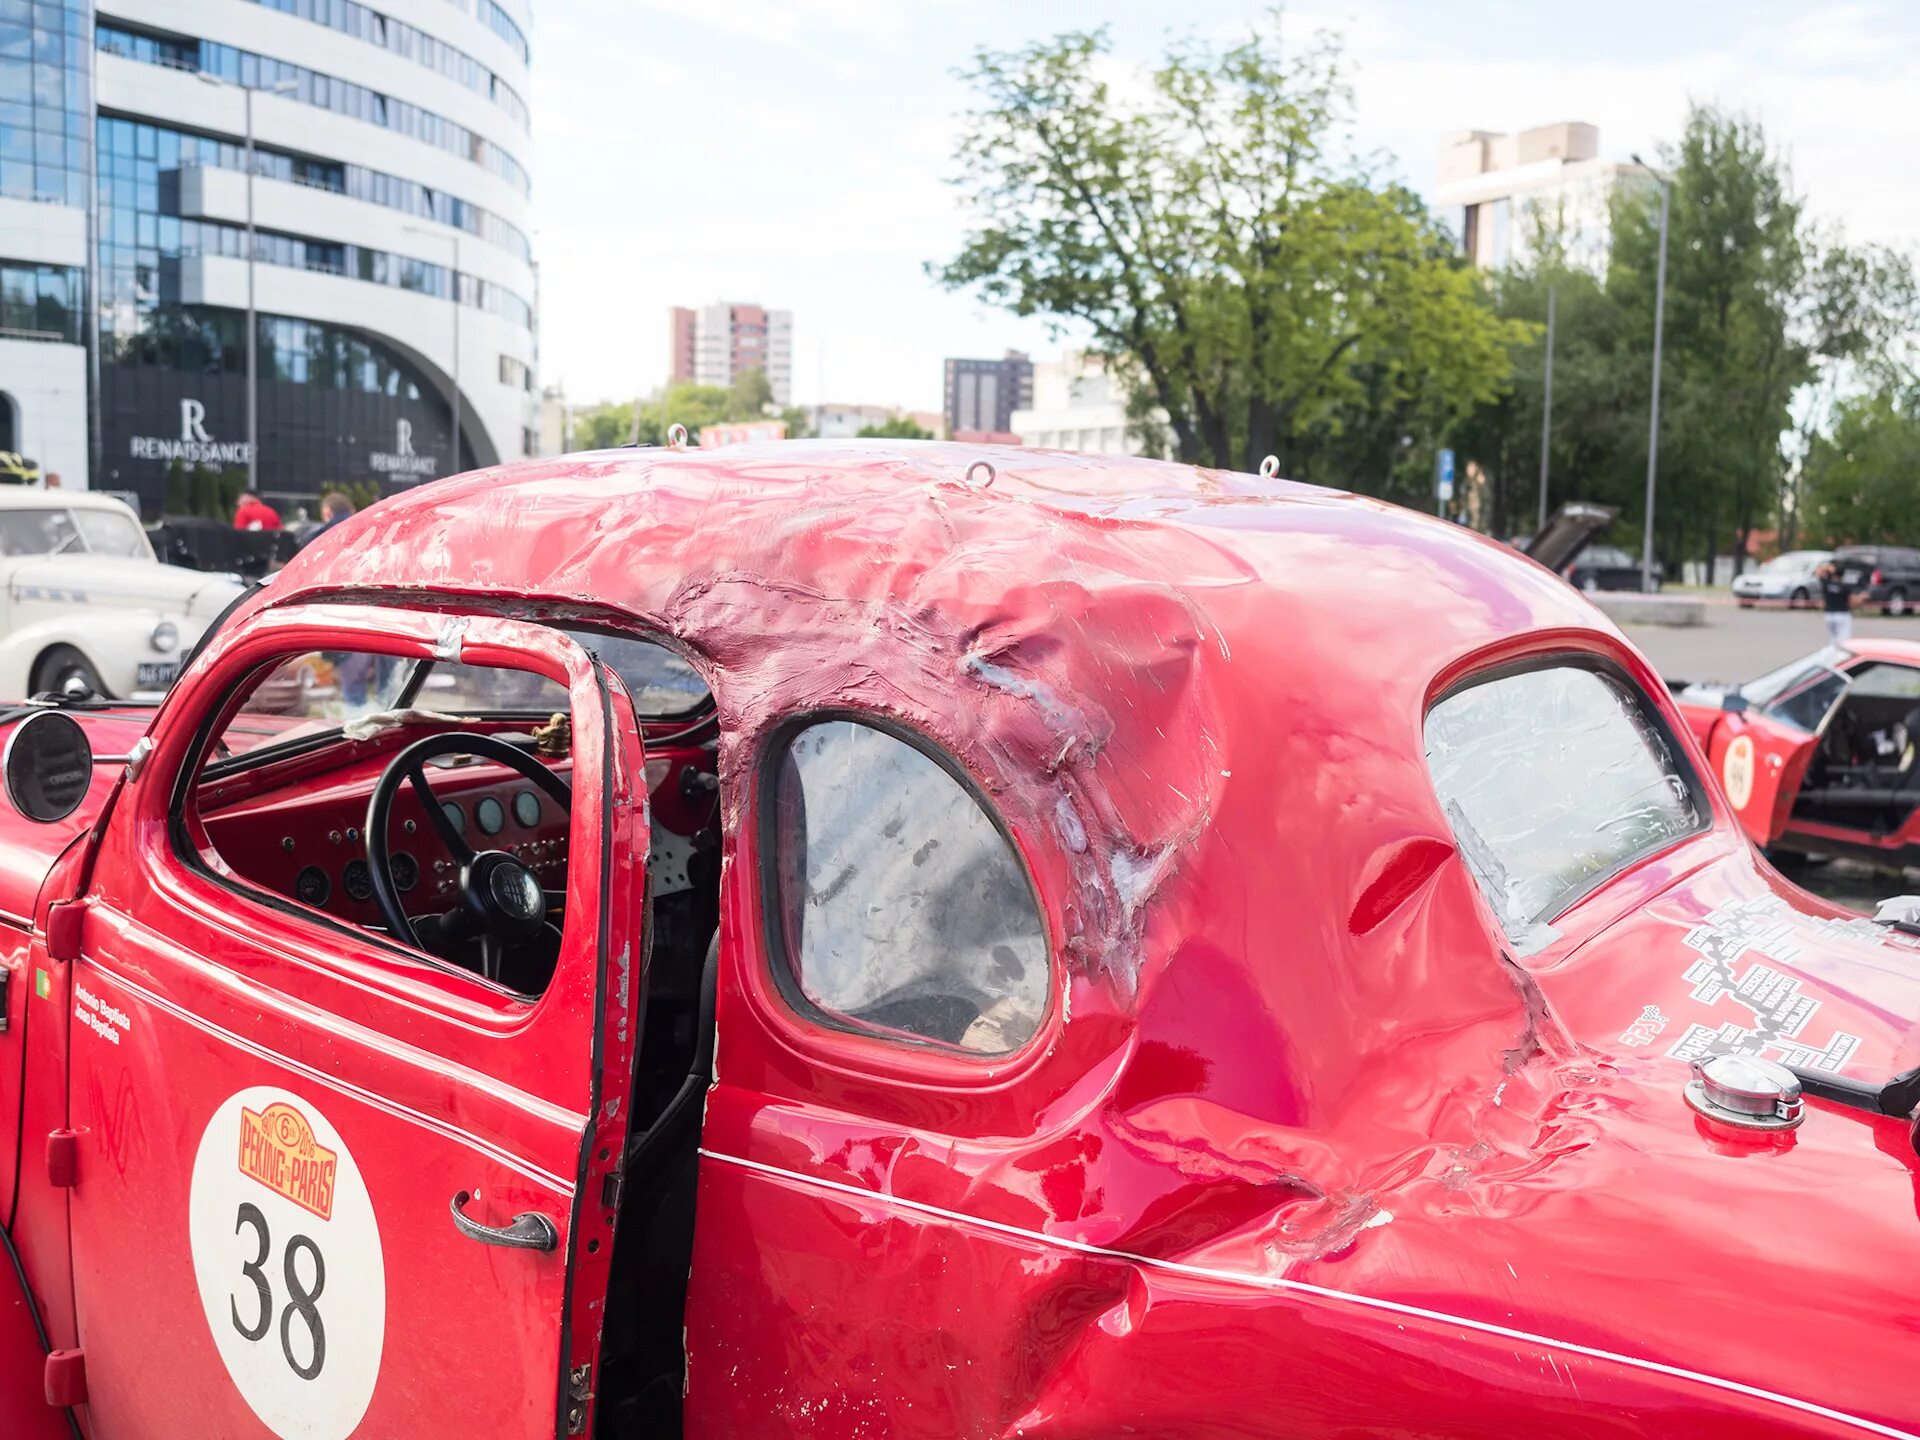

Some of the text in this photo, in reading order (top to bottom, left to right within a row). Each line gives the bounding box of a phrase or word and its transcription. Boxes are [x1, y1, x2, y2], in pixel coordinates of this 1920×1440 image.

[180, 398, 214, 441] R
[130, 436, 255, 464] RENAISSANCE
[396, 417, 416, 457] R
[369, 452, 438, 475] RENAISSANCE
[1763, 979, 1796, 1009] BUDAPEST
[1771, 993, 1801, 1022] MARIBOR
[91, 1013, 119, 1045] Baptista
[100, 999, 131, 1031] Baptista
[1779, 998, 1816, 1033] LJUBLJANA
[1674, 1027, 1719, 1057] PARIS
[299, 1126, 315, 1158] 2016
[241, 1114, 286, 1190] PEKING
[290, 1157, 334, 1214] PARIS
[230, 1202, 326, 1381] 38
